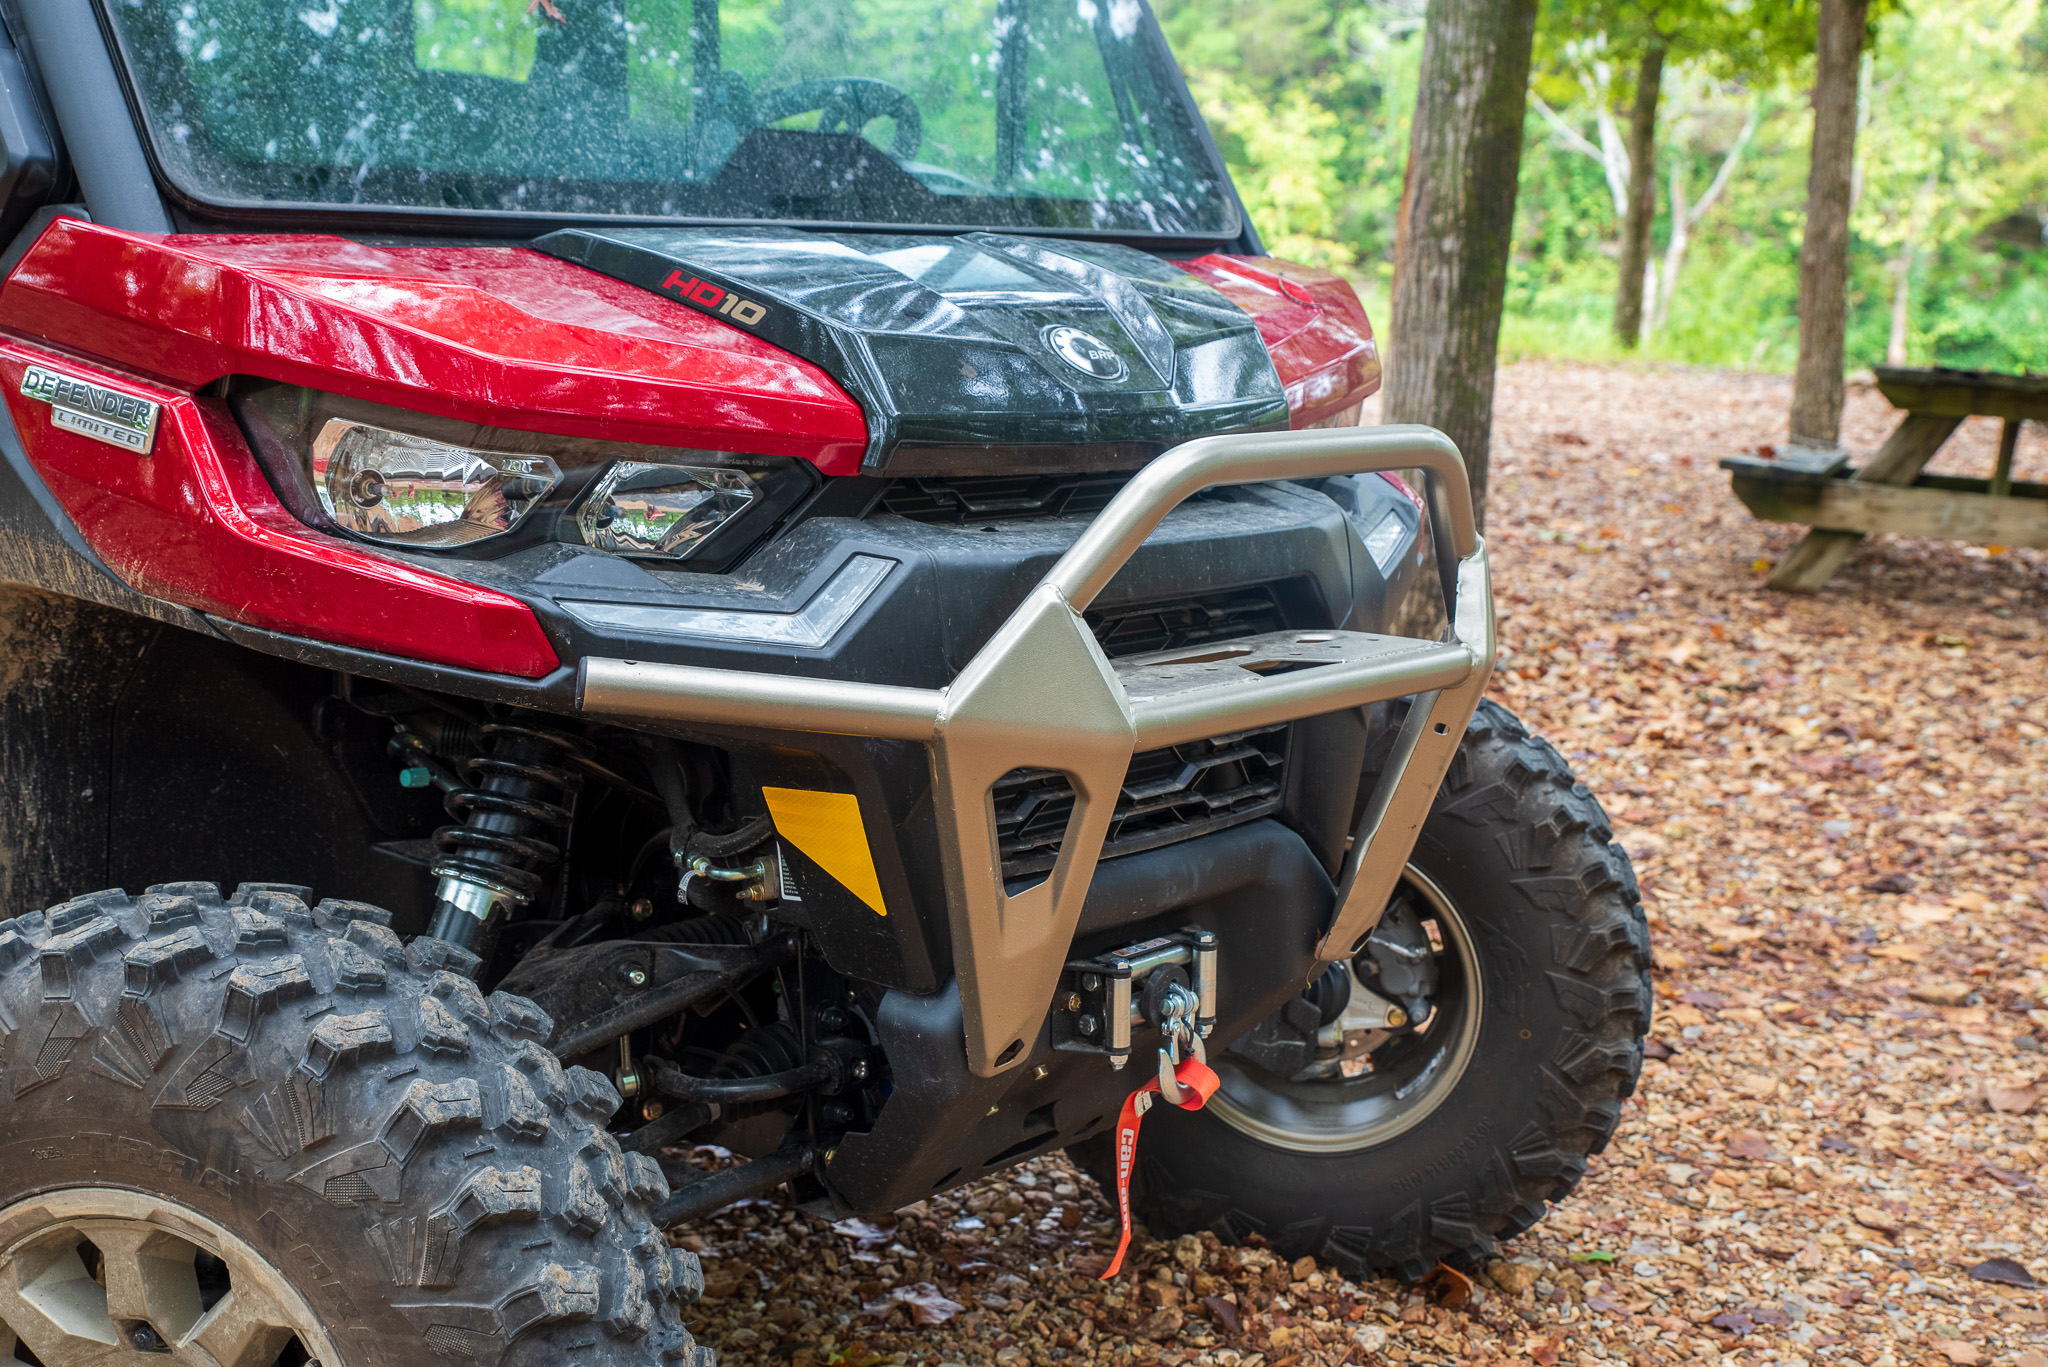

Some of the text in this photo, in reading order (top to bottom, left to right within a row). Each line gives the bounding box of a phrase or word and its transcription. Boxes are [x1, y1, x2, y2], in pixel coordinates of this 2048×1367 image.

[661, 269, 767, 325] HD10
[1088, 350, 1115, 360] BRP
[23, 370, 151, 427] DEFENDER
[57, 412, 141, 446] LIMITED
[1120, 1128, 1135, 1231] can-am
